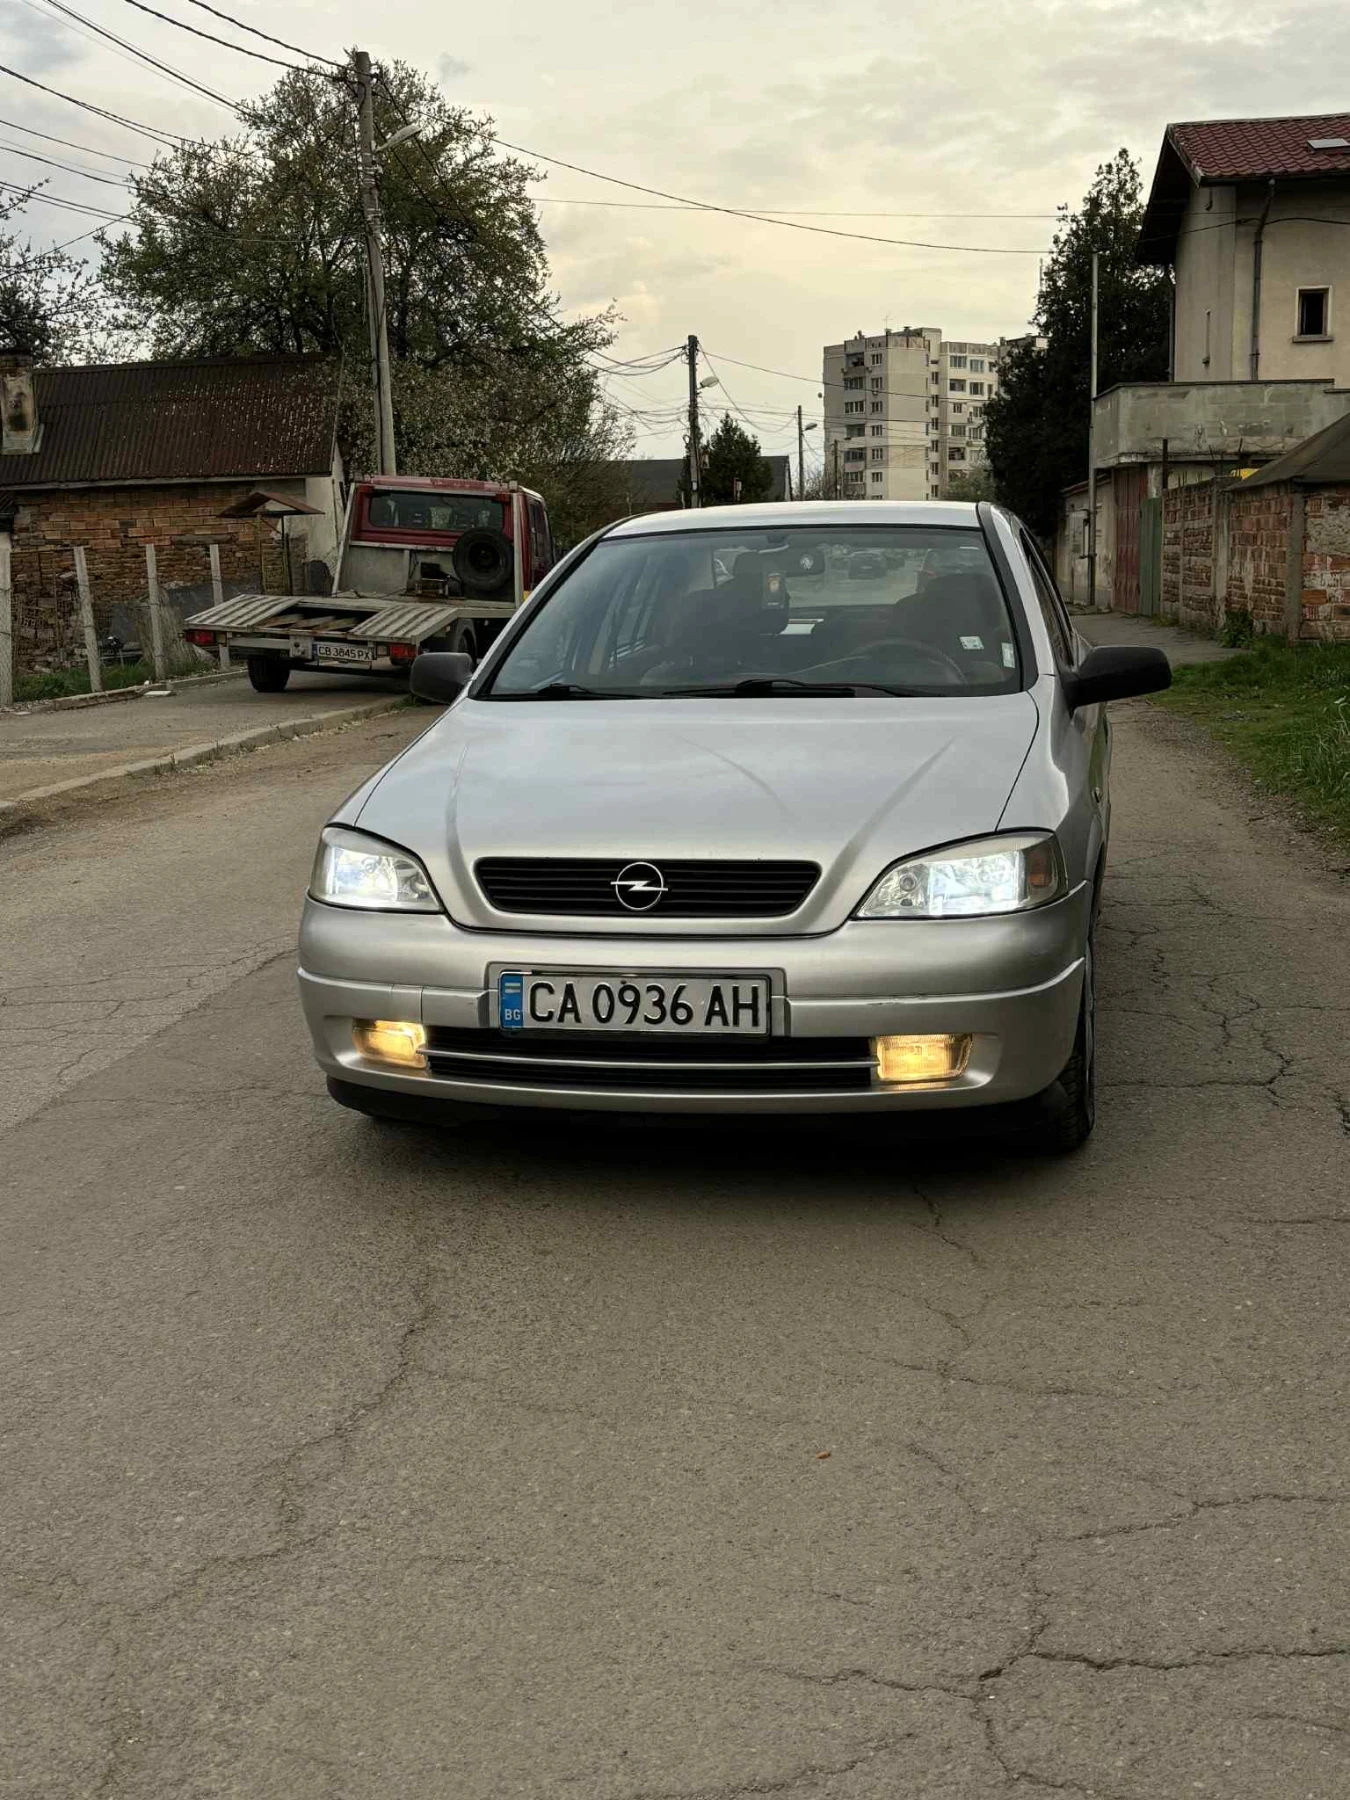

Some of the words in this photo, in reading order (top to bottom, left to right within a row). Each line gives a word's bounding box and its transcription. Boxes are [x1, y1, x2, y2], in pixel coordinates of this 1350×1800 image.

[318, 646, 331, 656] CB
[357, 650, 370, 660] PX
[529, 981, 582, 1024] CA
[592, 982, 694, 1026] 0936
[704, 984, 760, 1027] AH
[504, 1008, 521, 1021] BG
